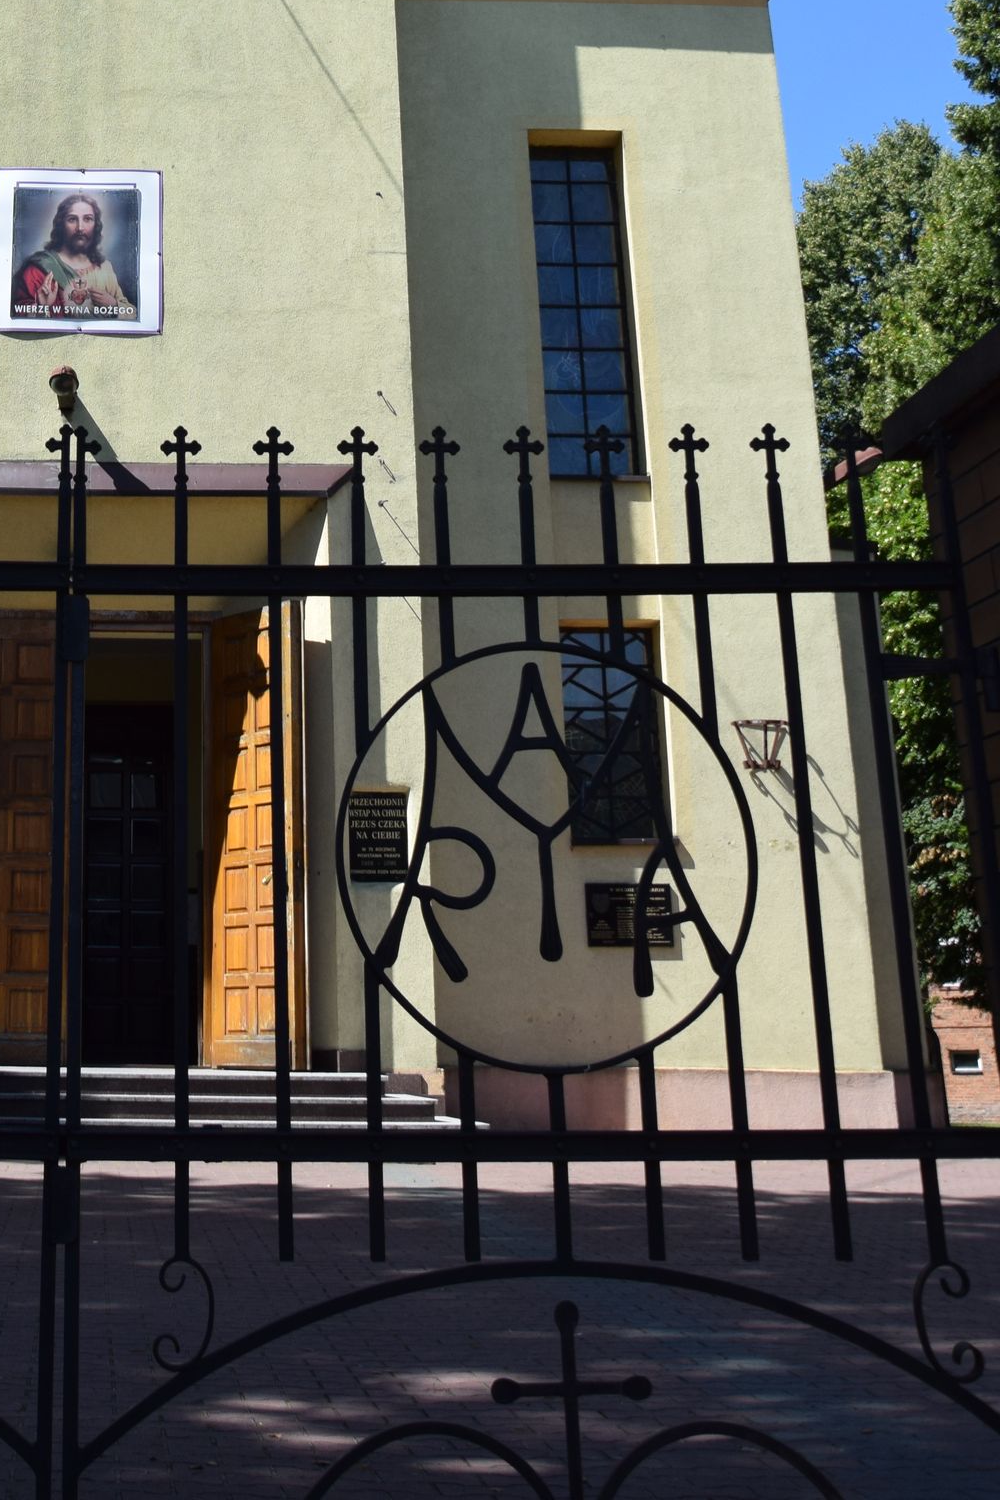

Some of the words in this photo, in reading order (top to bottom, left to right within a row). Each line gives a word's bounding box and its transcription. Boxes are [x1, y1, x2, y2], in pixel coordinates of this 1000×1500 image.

[52, 306, 61, 314] W
[64, 306, 91, 314] SYNA
[93, 304, 135, 315] BOŻEGO
[371, 809, 381, 818] NA
[350, 820, 377, 828] JEZUS
[378, 820, 406, 828] CZEKA
[356, 831, 368, 840] NA
[371, 831, 401, 840] CIEBIE
